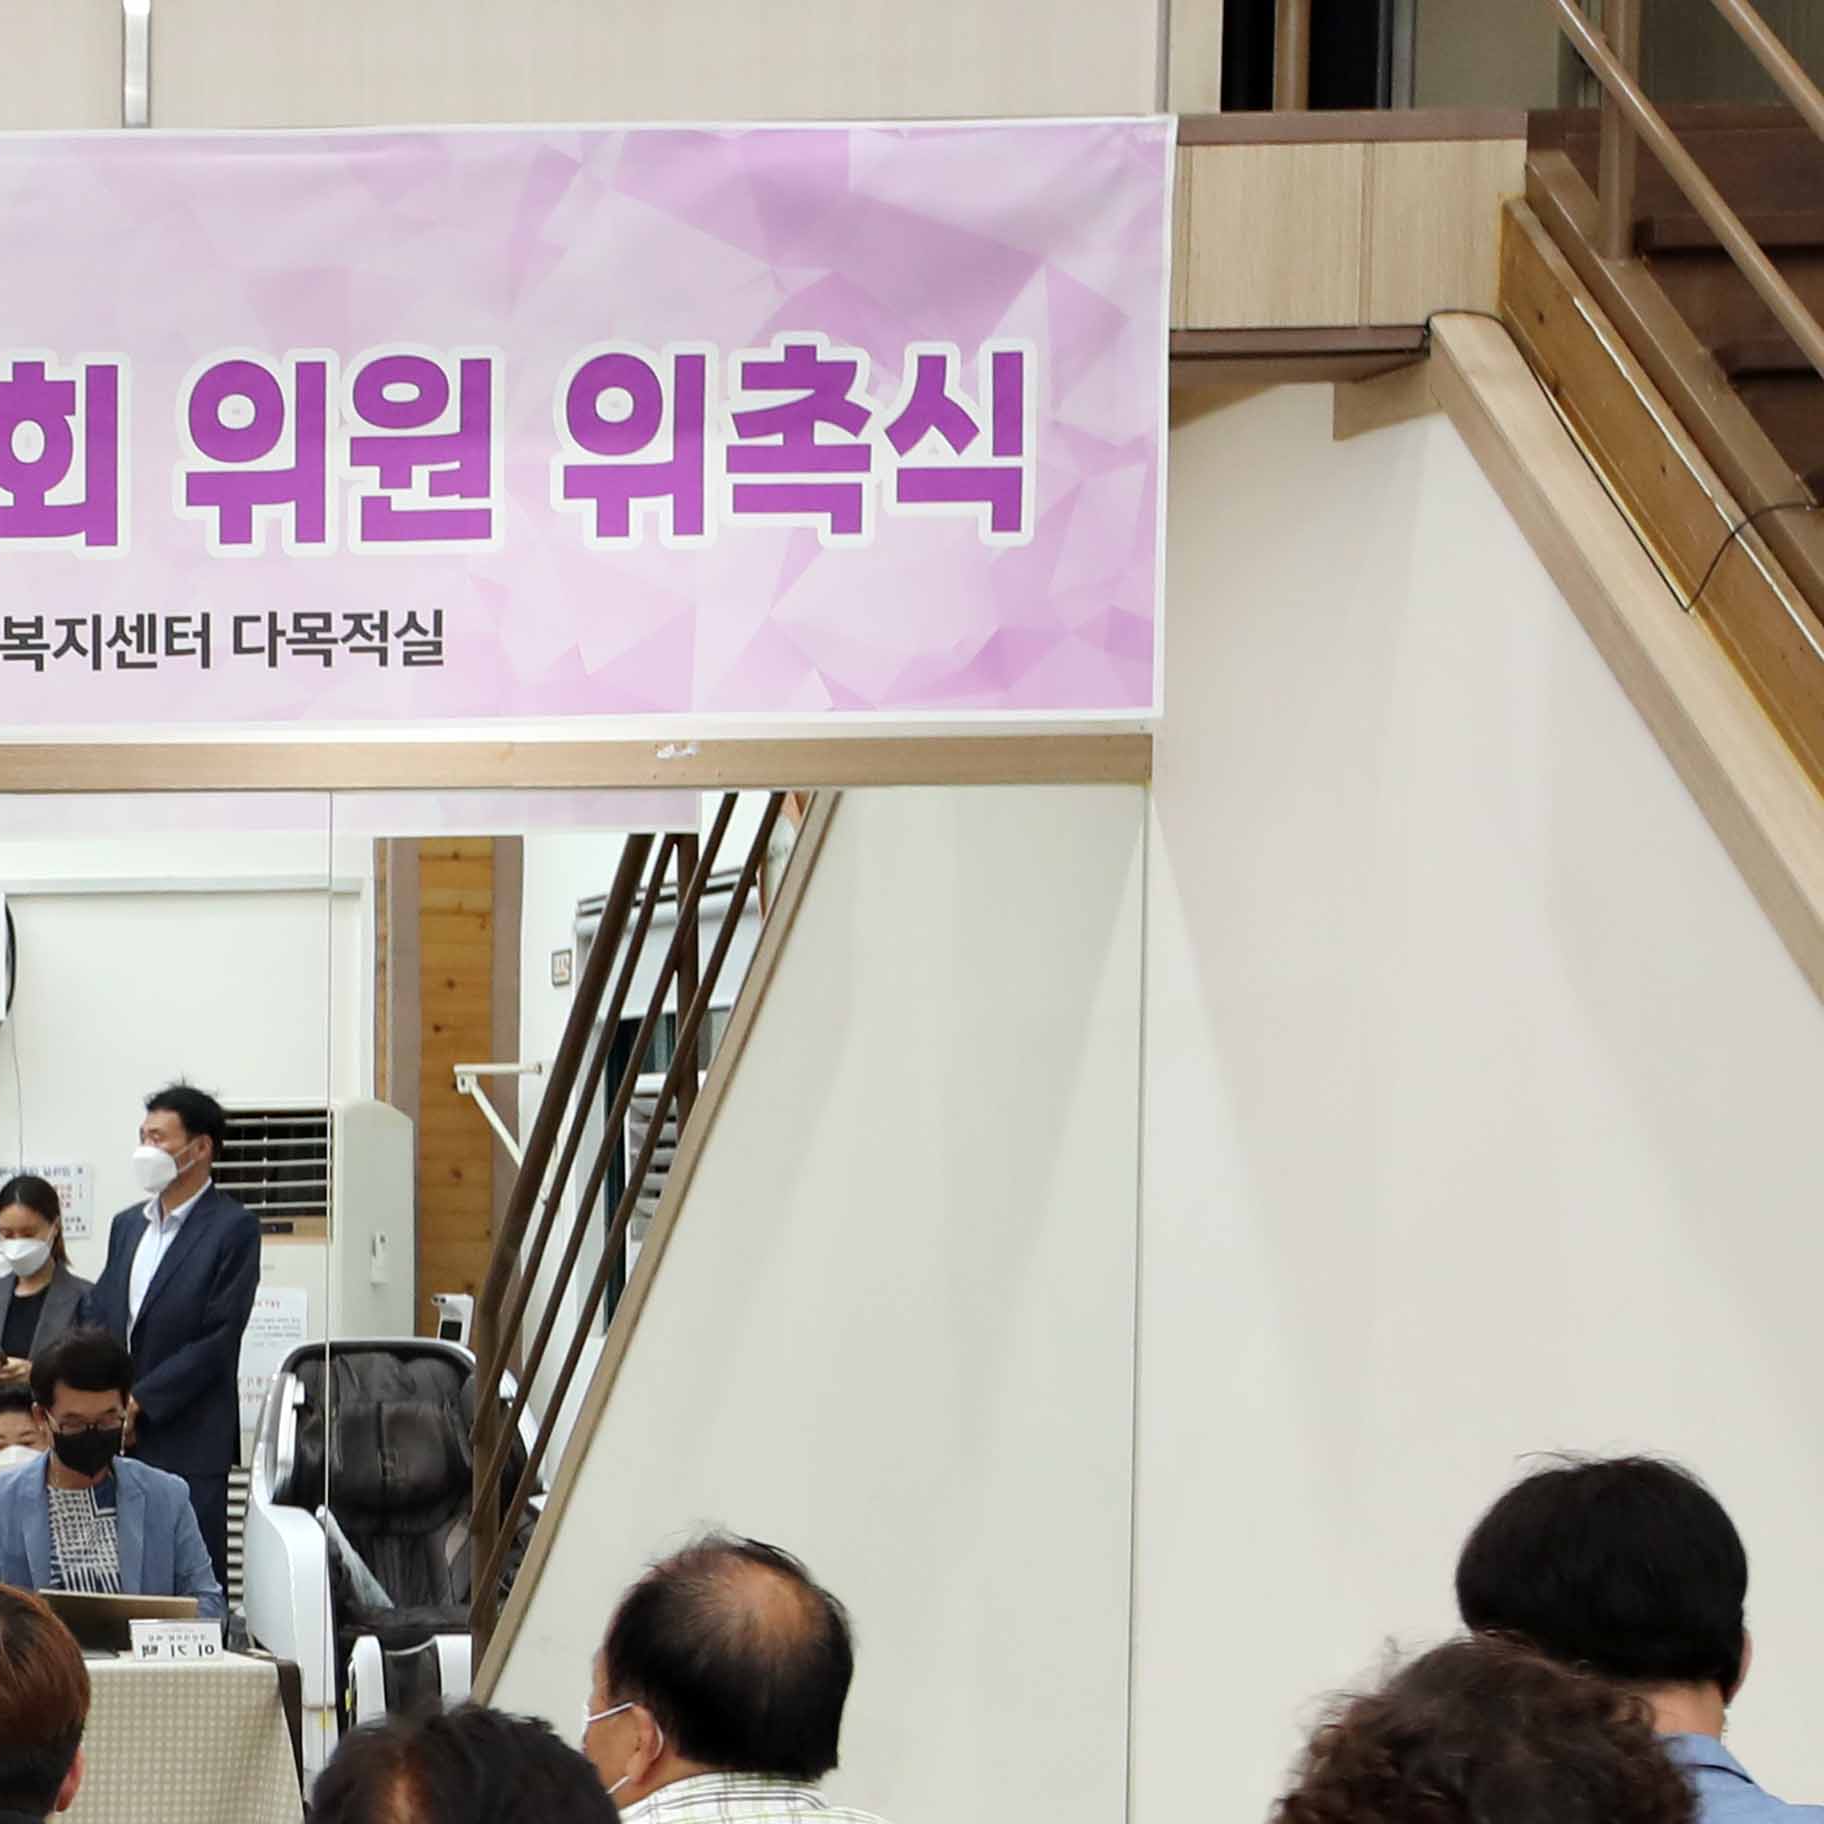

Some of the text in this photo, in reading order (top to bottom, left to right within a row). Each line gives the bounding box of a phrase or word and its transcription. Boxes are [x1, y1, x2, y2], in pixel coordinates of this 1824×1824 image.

[188, 358, 490, 543] 위원
[566, 346, 1021, 536] 위촉식
[233, 609, 444, 669] 다목적실
